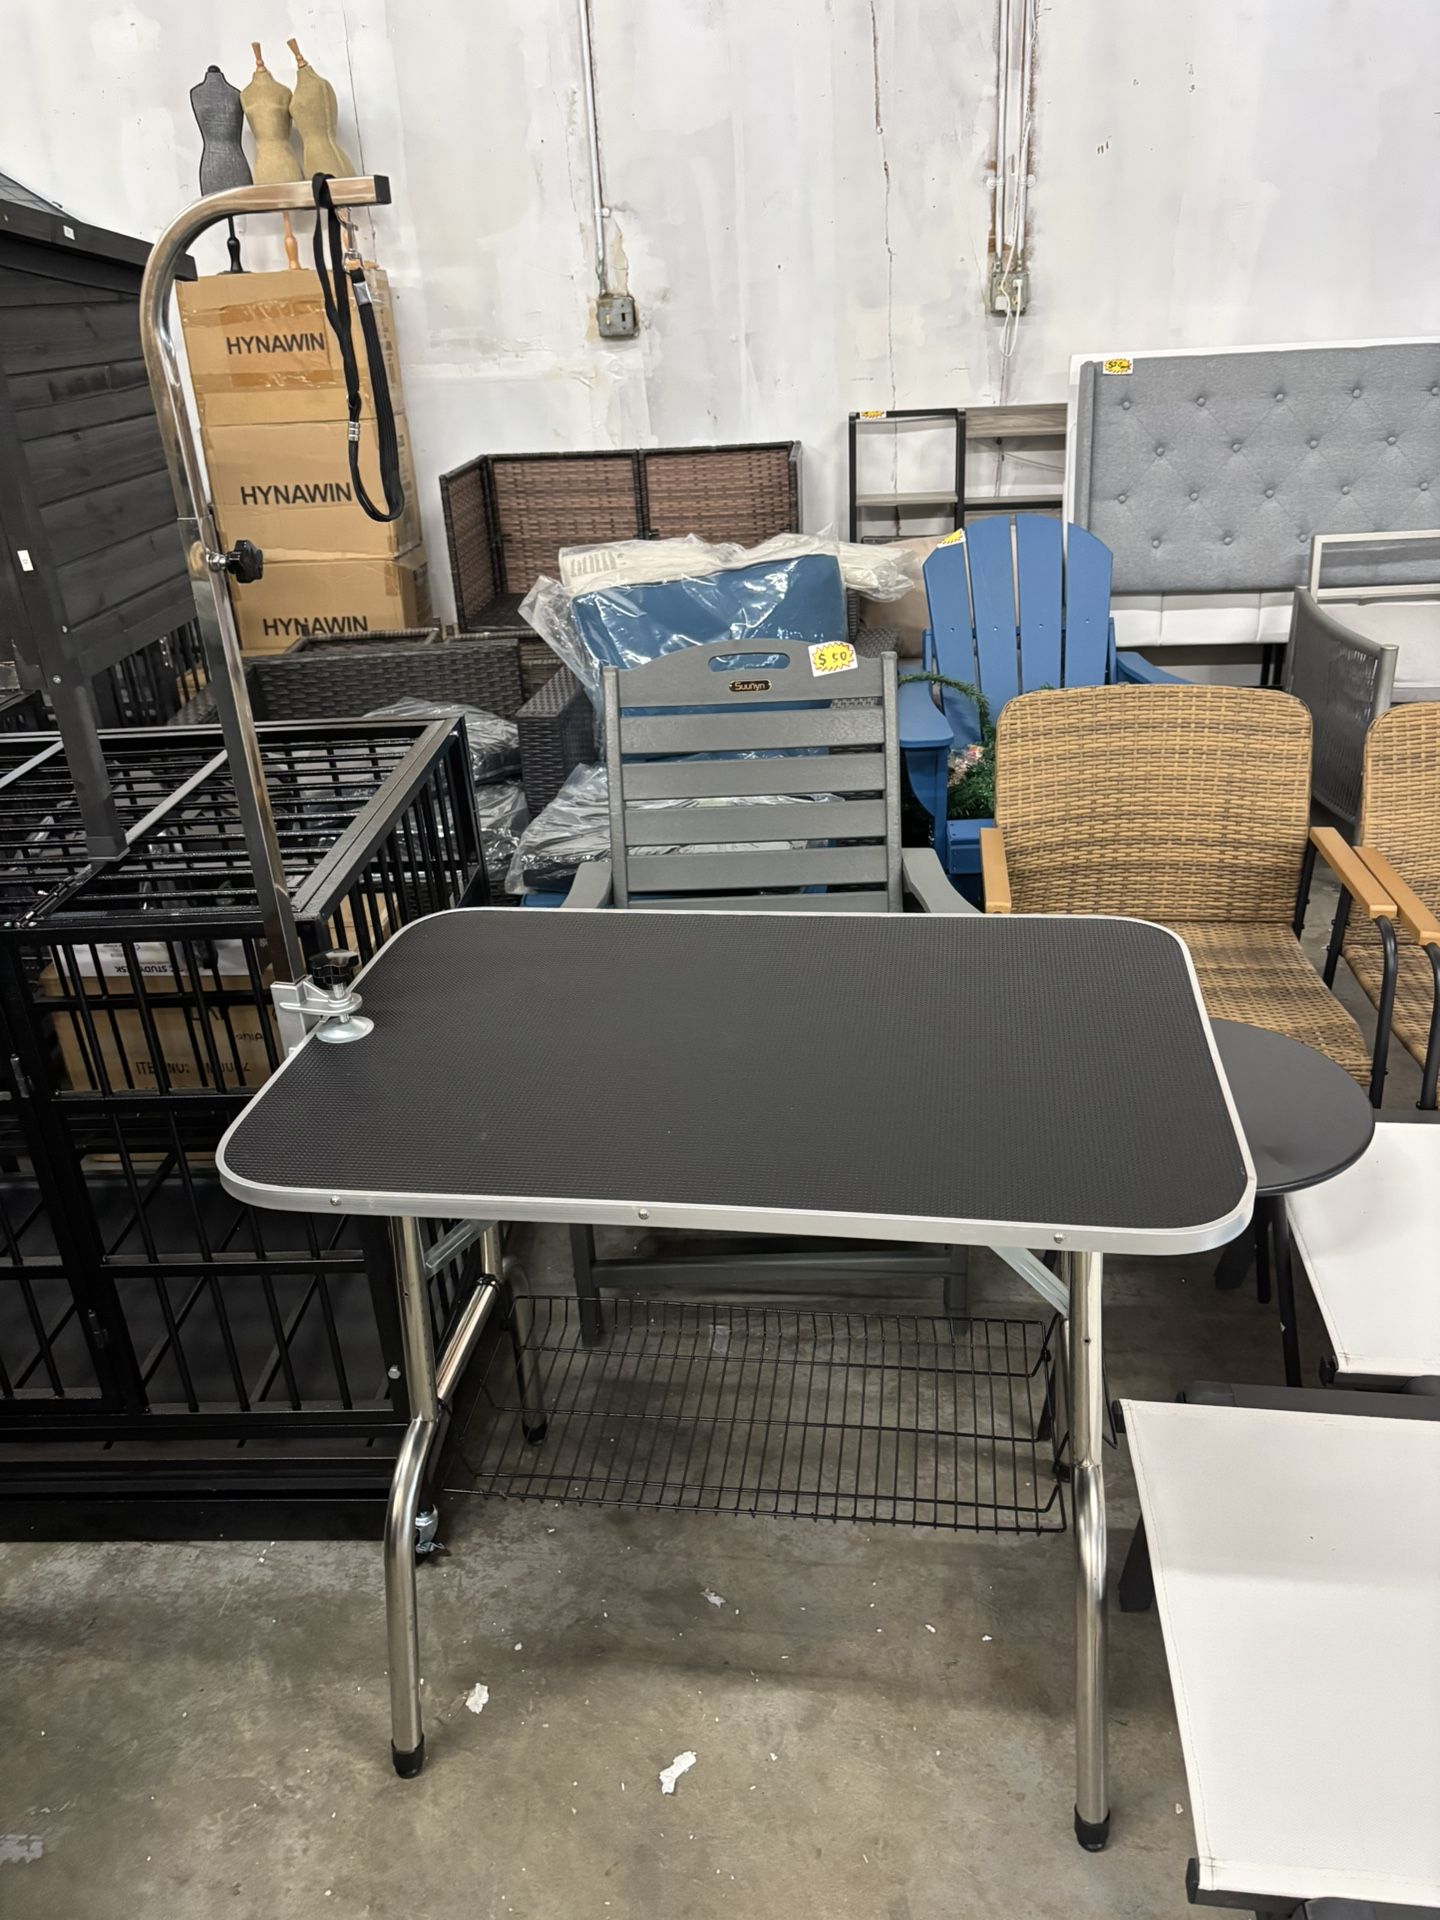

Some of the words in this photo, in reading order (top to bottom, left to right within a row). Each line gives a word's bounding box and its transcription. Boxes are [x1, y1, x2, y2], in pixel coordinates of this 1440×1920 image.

[226, 333, 325, 355] HYNAWIN
[240, 482, 352, 505] HYNAWIN
[263, 616, 368, 636] HYNAWIN
